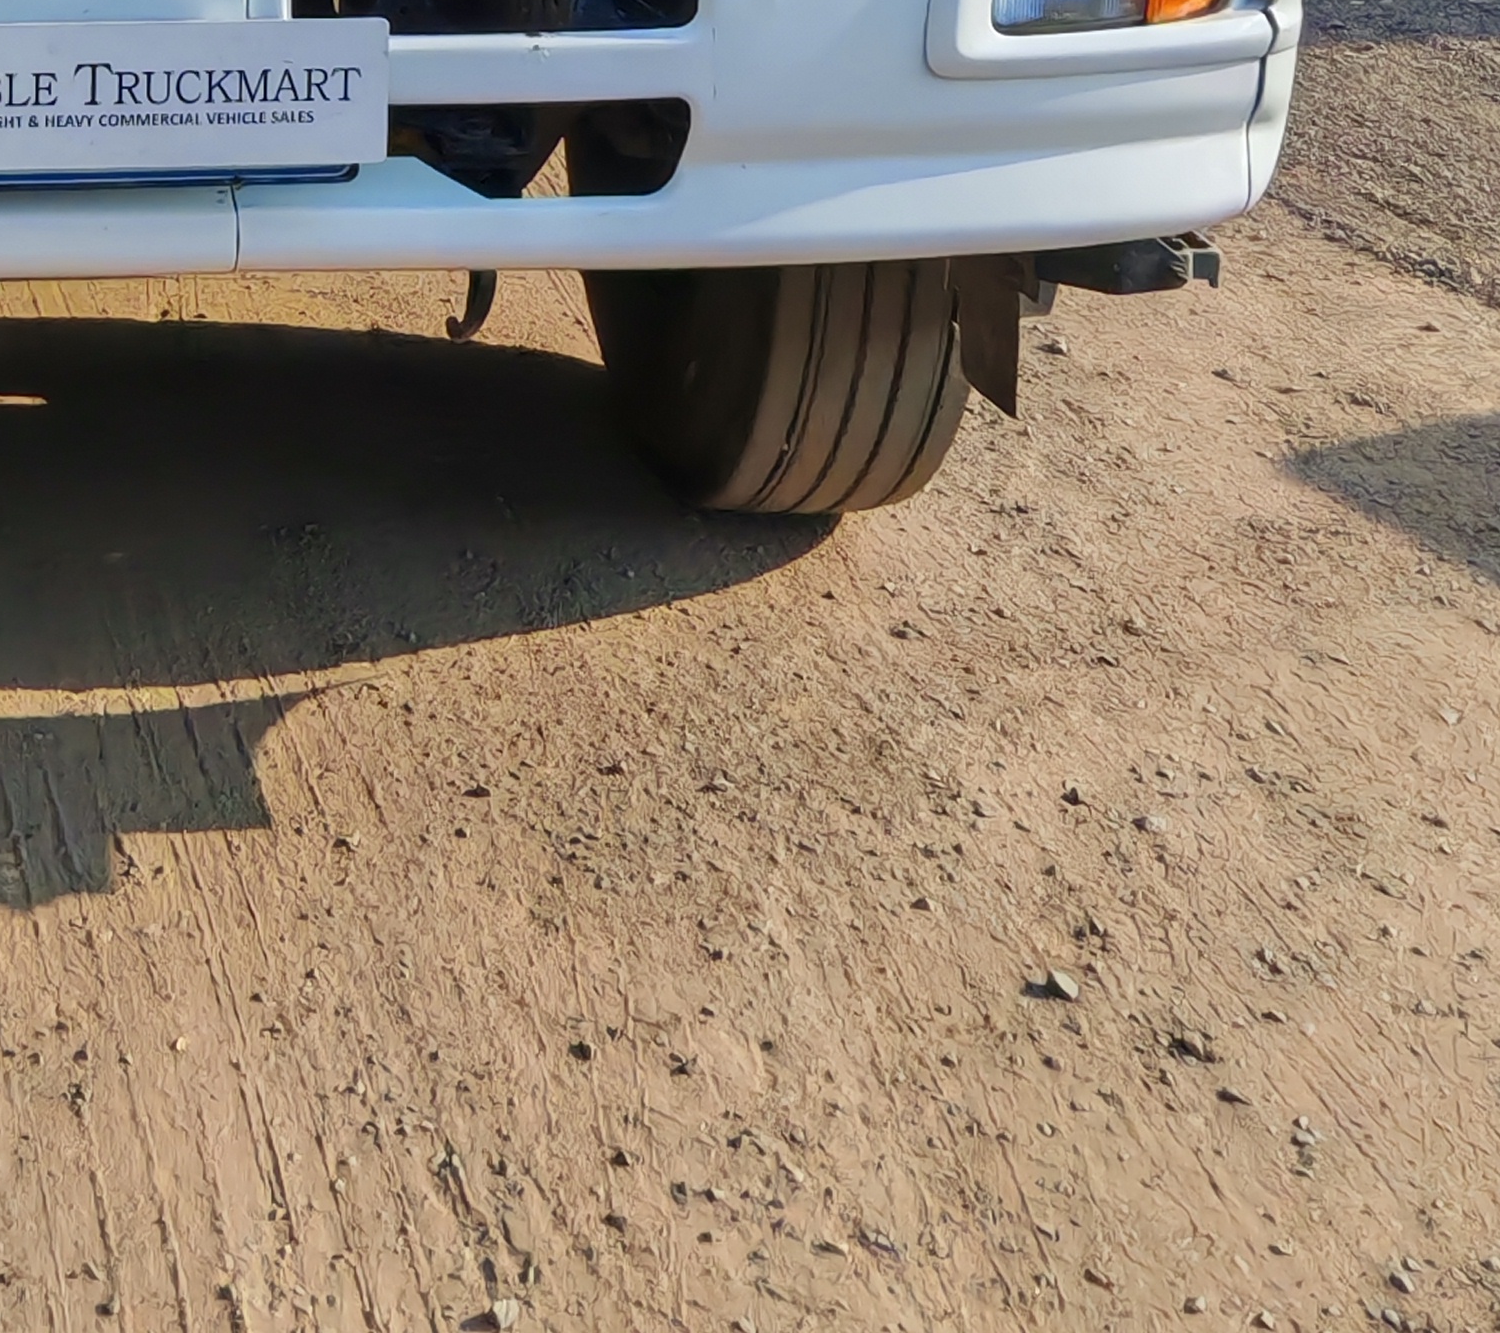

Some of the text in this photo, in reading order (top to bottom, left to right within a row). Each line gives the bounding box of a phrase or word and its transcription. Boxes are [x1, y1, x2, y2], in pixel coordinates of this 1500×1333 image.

[73, 62, 362, 107] TRUCKMART
[27, 115, 40, 129] &
[44, 113, 95, 129] HEAVY
[98, 112, 202, 128] COMMERCIAL
[205, 110, 268, 125] VEHICLE
[270, 109, 316, 125] SALES
